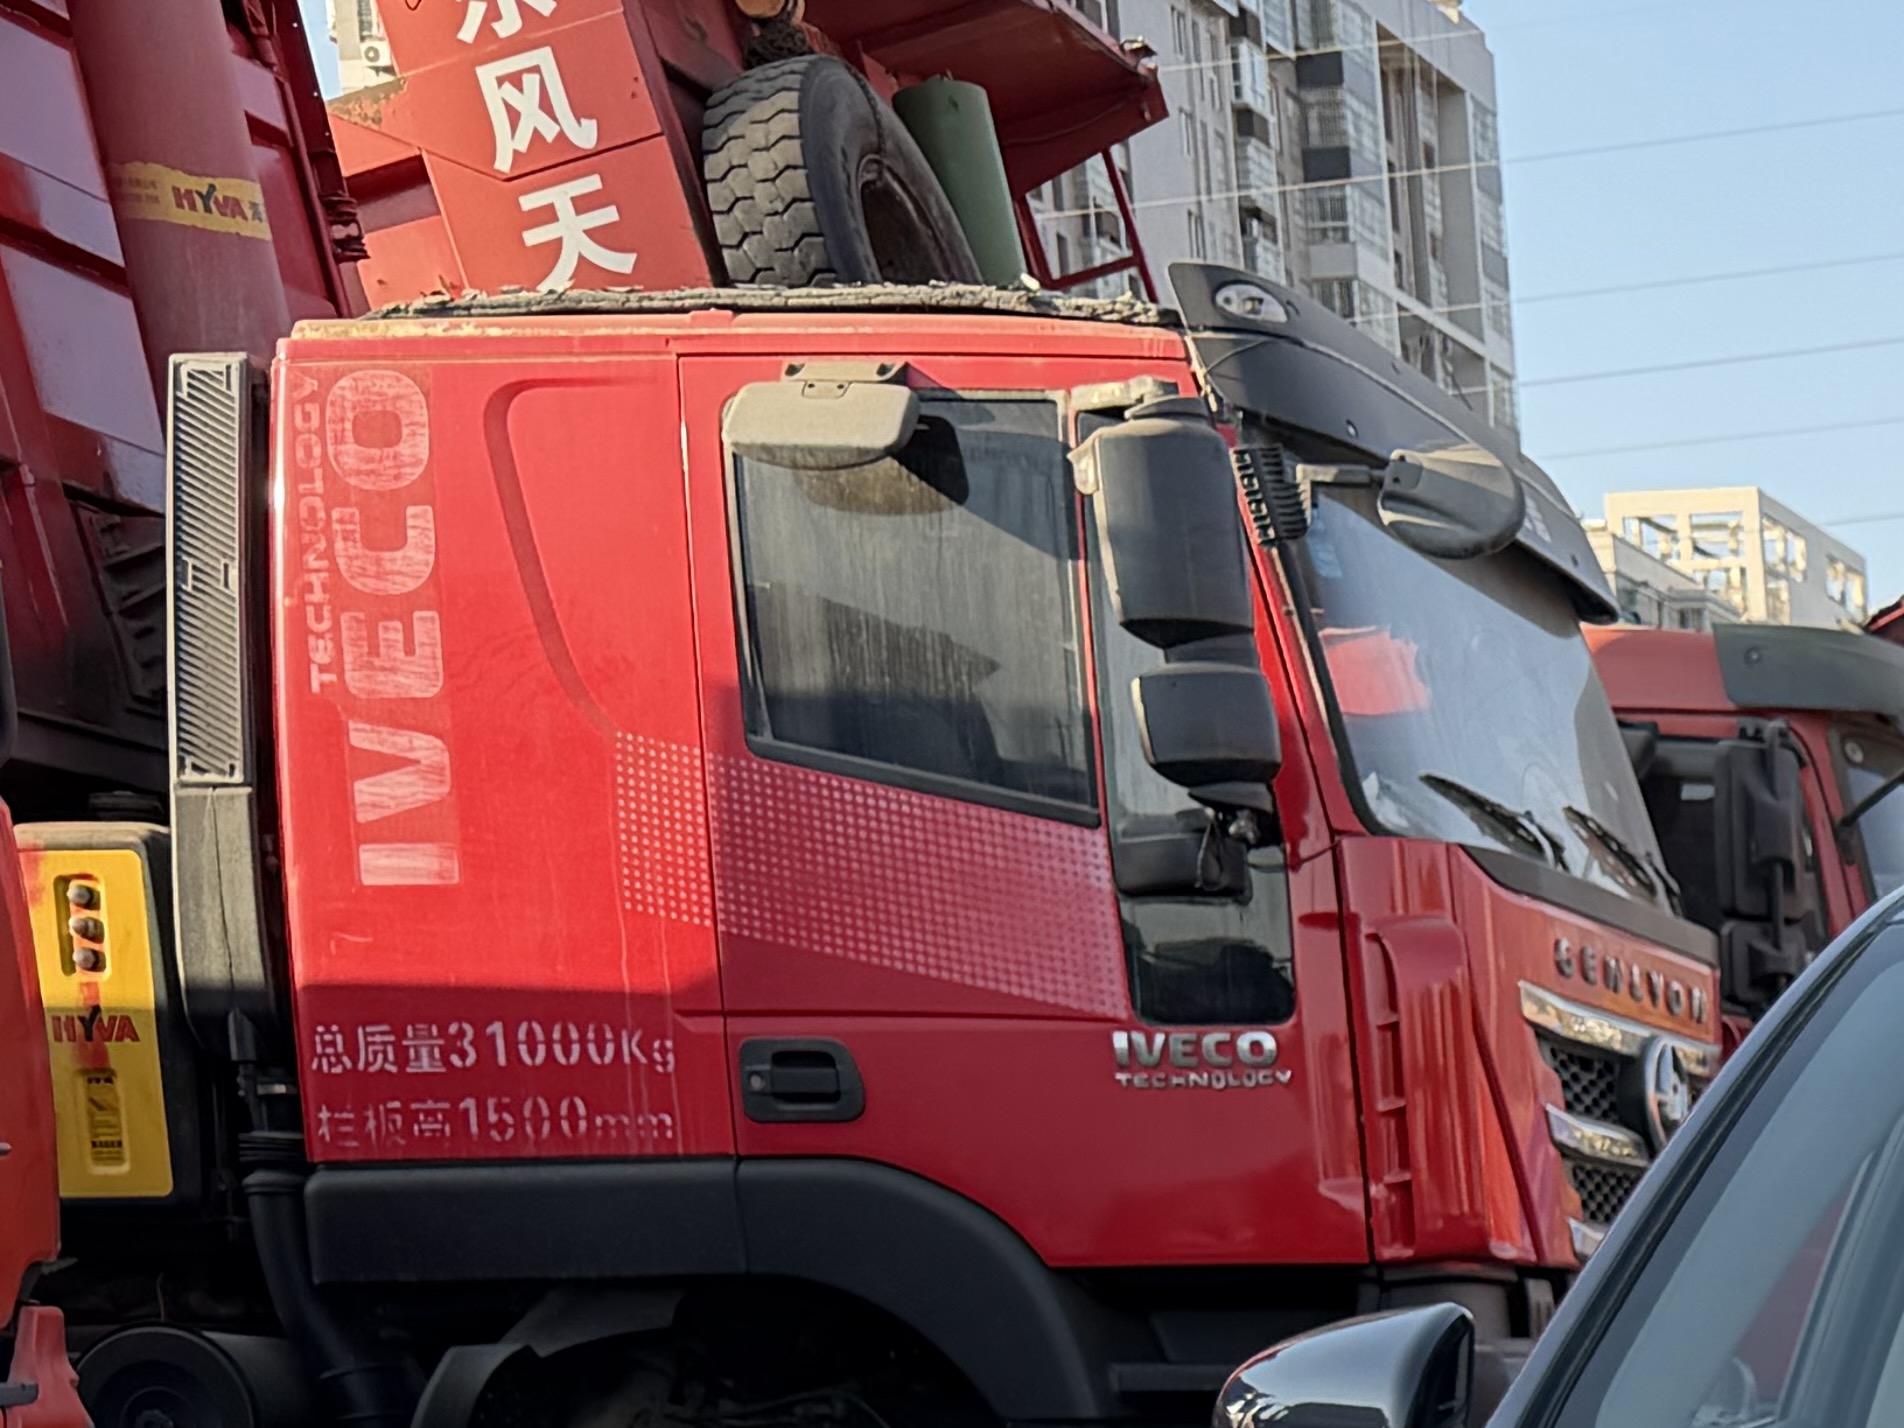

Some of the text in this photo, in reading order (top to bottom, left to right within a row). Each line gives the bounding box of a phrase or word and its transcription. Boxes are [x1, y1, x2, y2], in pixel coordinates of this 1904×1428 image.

[172, 183, 248, 221] HYVA
[295, 376, 338, 693] TECHNOLOGY
[326, 369, 460, 885] IVECO
[1555, 937, 1708, 1024] GENLYON
[51, 1005, 140, 1042] HYVA
[1112, 1030, 1277, 1067] IVECO
[1114, 1069, 1292, 1089] TECHNOLOGY
